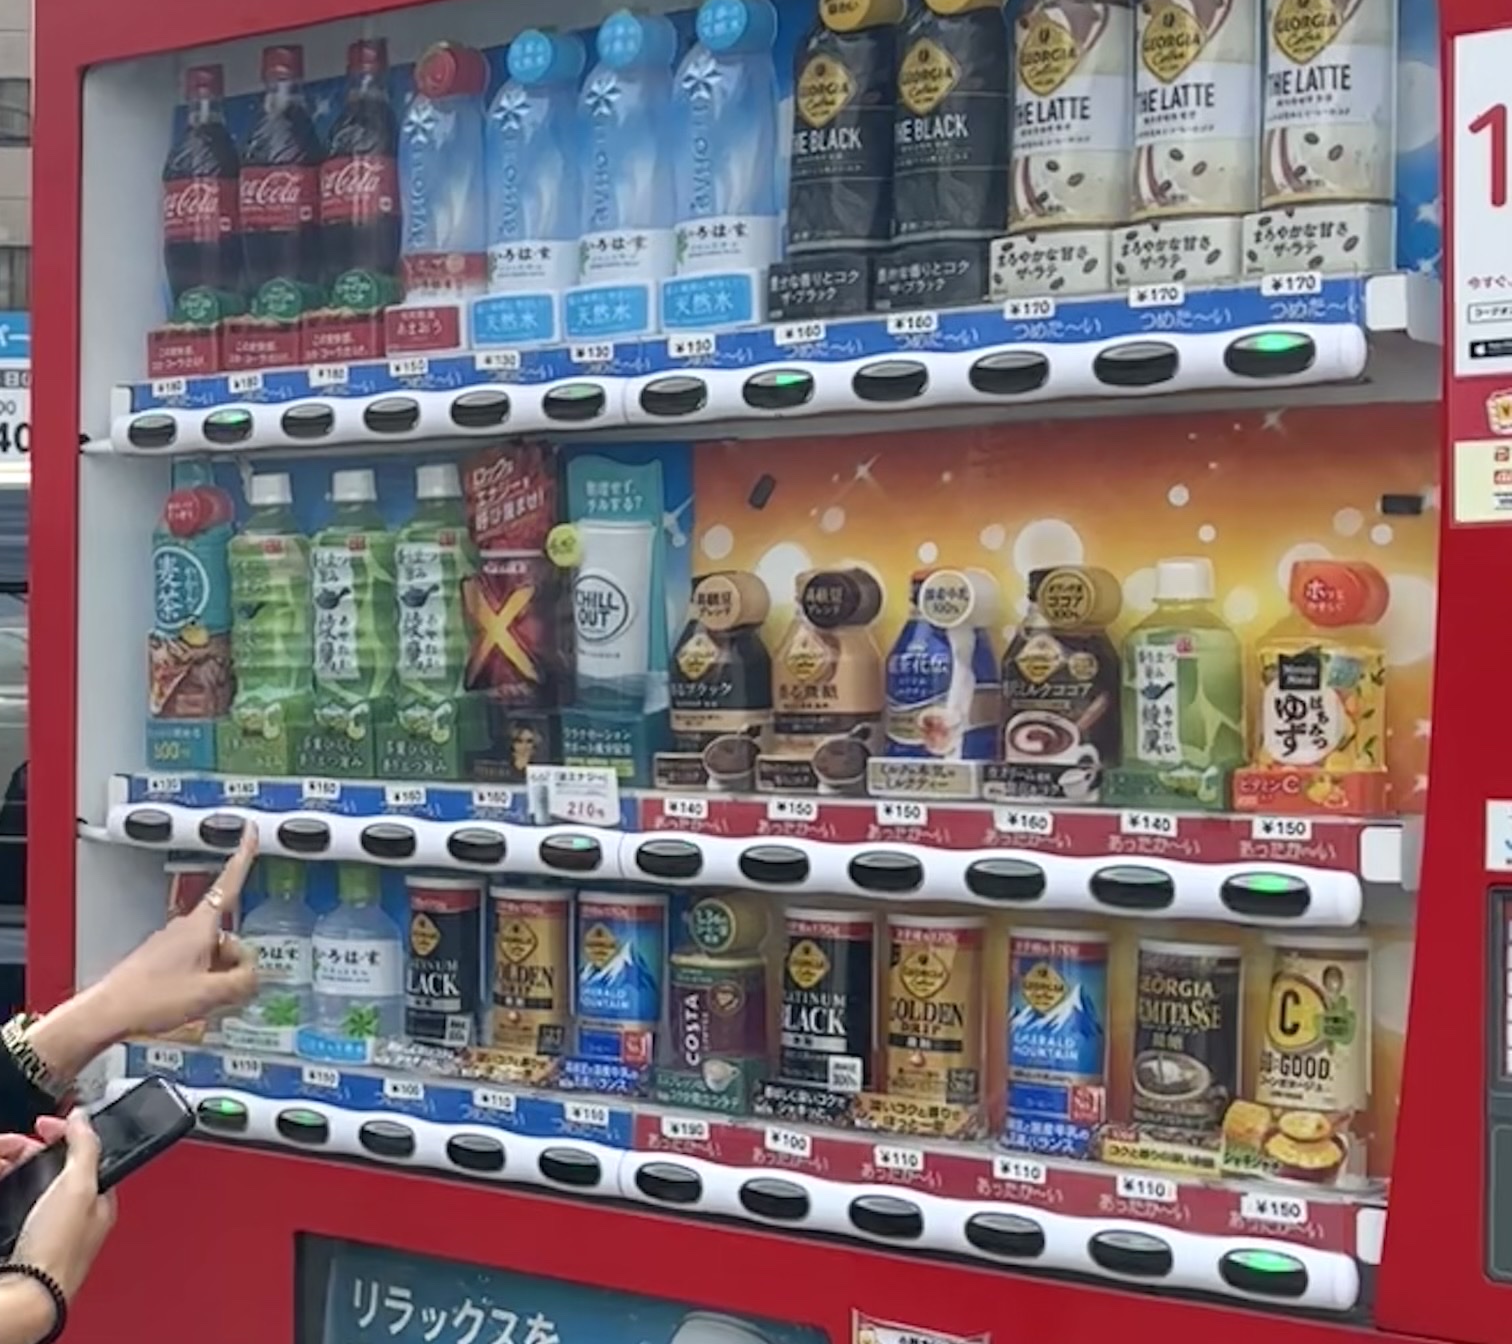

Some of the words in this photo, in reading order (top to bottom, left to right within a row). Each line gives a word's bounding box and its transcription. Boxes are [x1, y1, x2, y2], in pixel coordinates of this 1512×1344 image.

[1295, 63, 1352, 92] LATTE
[1160, 82, 1215, 109] LATTE
[1036, 96, 1092, 123] LATTE
[914, 113, 969, 138] BLACK
[809, 126, 863, 150] BLACK
[1252, 218, 1350, 243] まろやかな甘さ
[995, 244, 1089, 270] まろやかな甘さ
[1119, 233, 1212, 258] まろやかな甘さ
[1271, 273, 1316, 291] ¥170
[673, 290, 735, 315] 天然水
[1137, 286, 1179, 303] ¥170
[575, 302, 633, 326] 天然水
[1010, 299, 1050, 315] ¥170
[488, 311, 538, 332] 天然水
[156, 554, 184, 622] 麦茶
[576, 590, 619, 612] CHILL
[1048, 595, 1084, 607] ココア
[578, 609, 611, 628] OUT
[1275, 693, 1307, 757] ゆず
[1309, 693, 1329, 750] はちみつ
[669, 801, 704, 815] ¥140
[884, 803, 921, 819] ¥150
[1008, 812, 1049, 831] ¥160
[1129, 814, 1171, 832] ¥140
[1262, 819, 1307, 836] ¥150
[257, 946, 300, 961] ろはす
[405, 972, 461, 997] LACK
[1140, 973, 1215, 999] EORGIA
[1140, 999, 1222, 1030] EMITASSE
[1279, 988, 1301, 1036] C
[685, 993, 700, 1067] COSTA
[771, 1128, 807, 1151] ¥100
[880, 1149, 918, 1167] ¥110
[1000, 1159, 1041, 1180] ¥110
[1123, 1176, 1166, 1198] ¥110
[1255, 1198, 1301, 1218] ¥150
